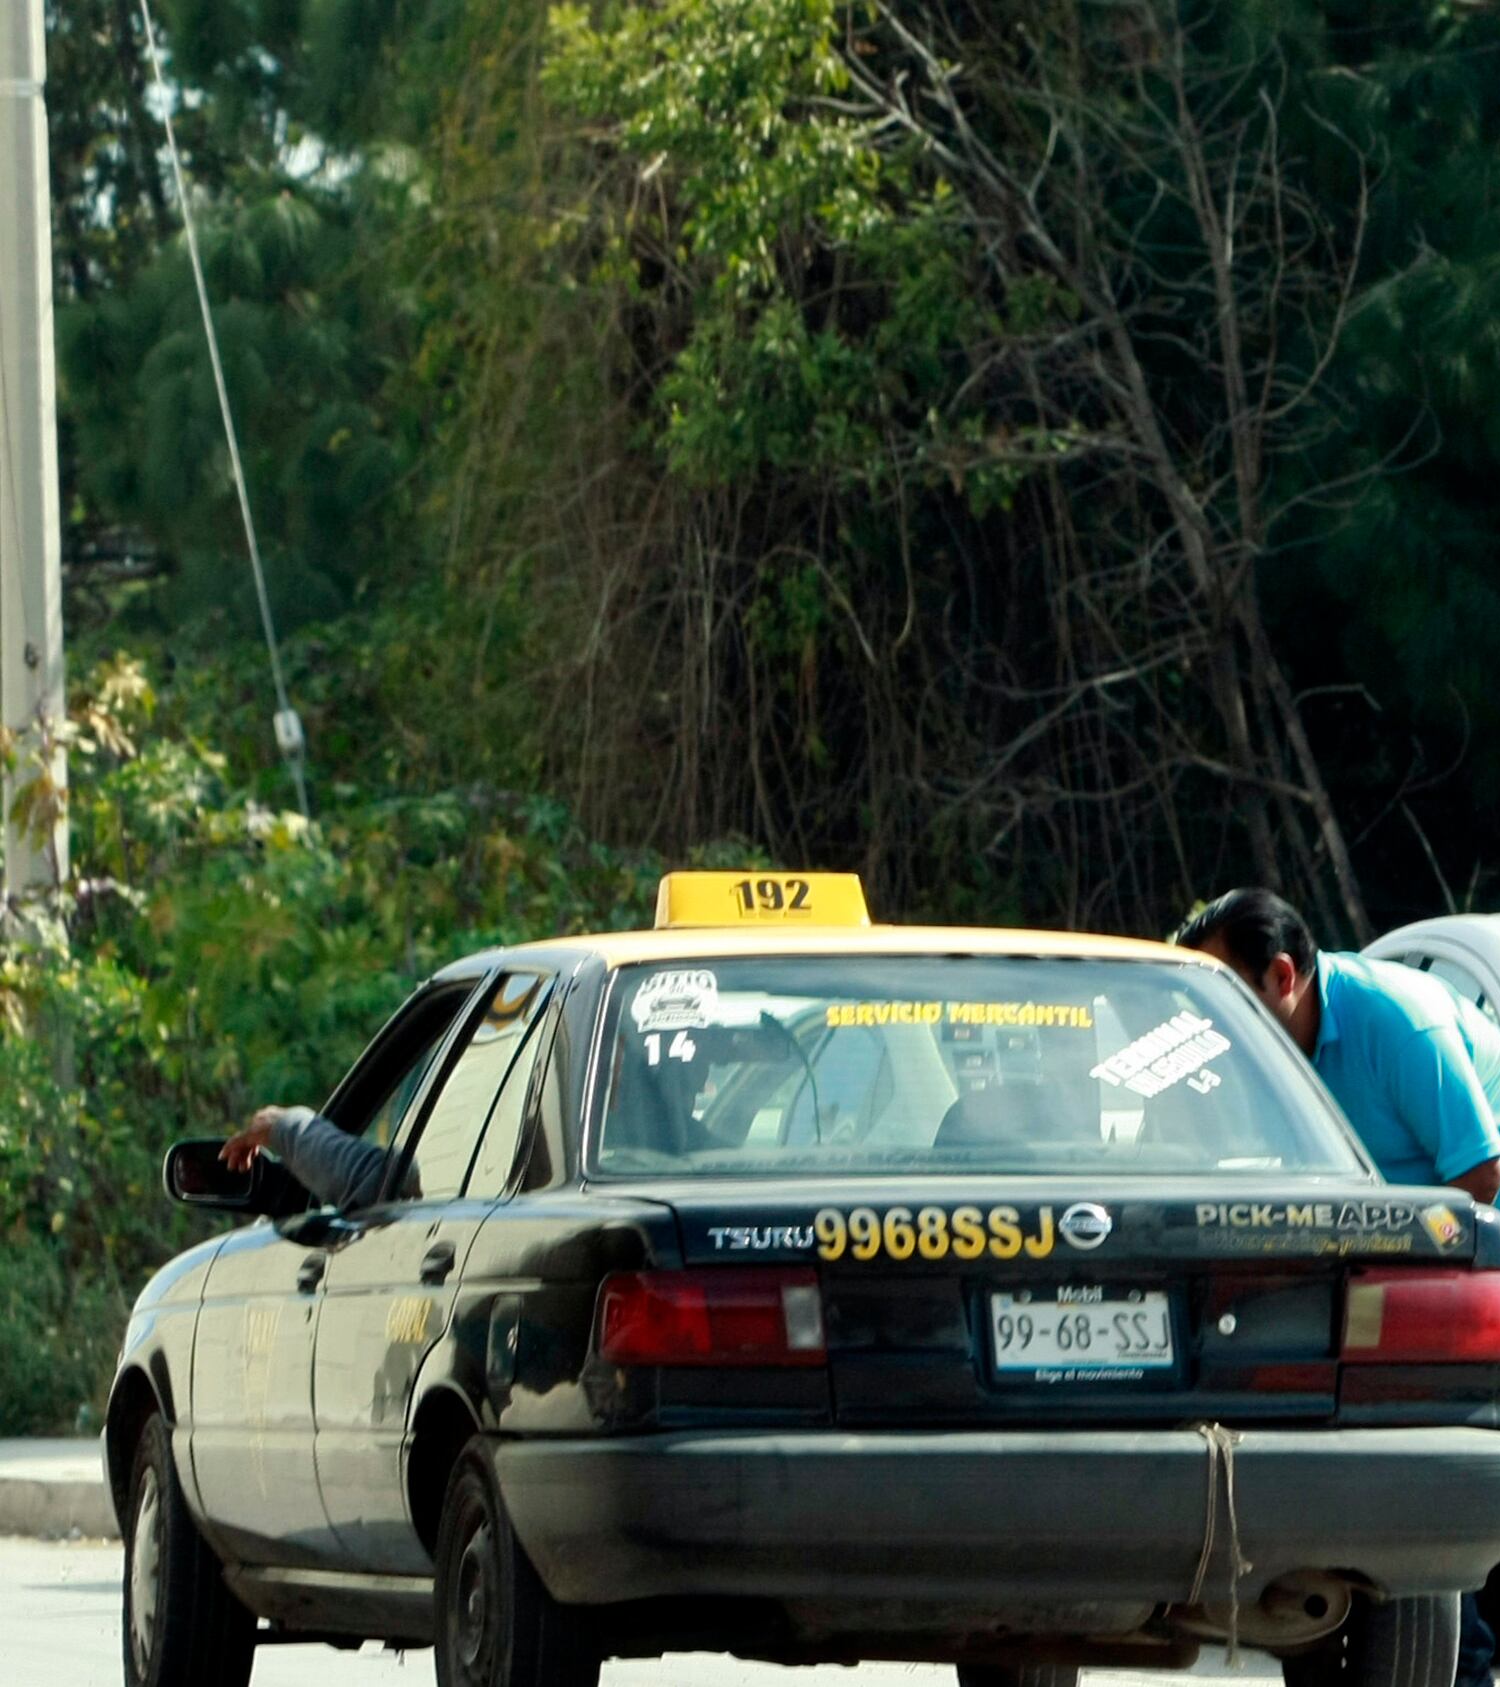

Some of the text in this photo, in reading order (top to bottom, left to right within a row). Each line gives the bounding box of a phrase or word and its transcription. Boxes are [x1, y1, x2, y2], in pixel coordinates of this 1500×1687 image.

[735, 879, 812, 911] 192
[826, 1001, 942, 1027] SERVICIO
[1195, 1202, 1416, 1231] PICK-ME APP
[707, 1206, 1055, 1262] TSURU 9968SSJ
[998, 1310, 1170, 1351] 99-68-SSJ
